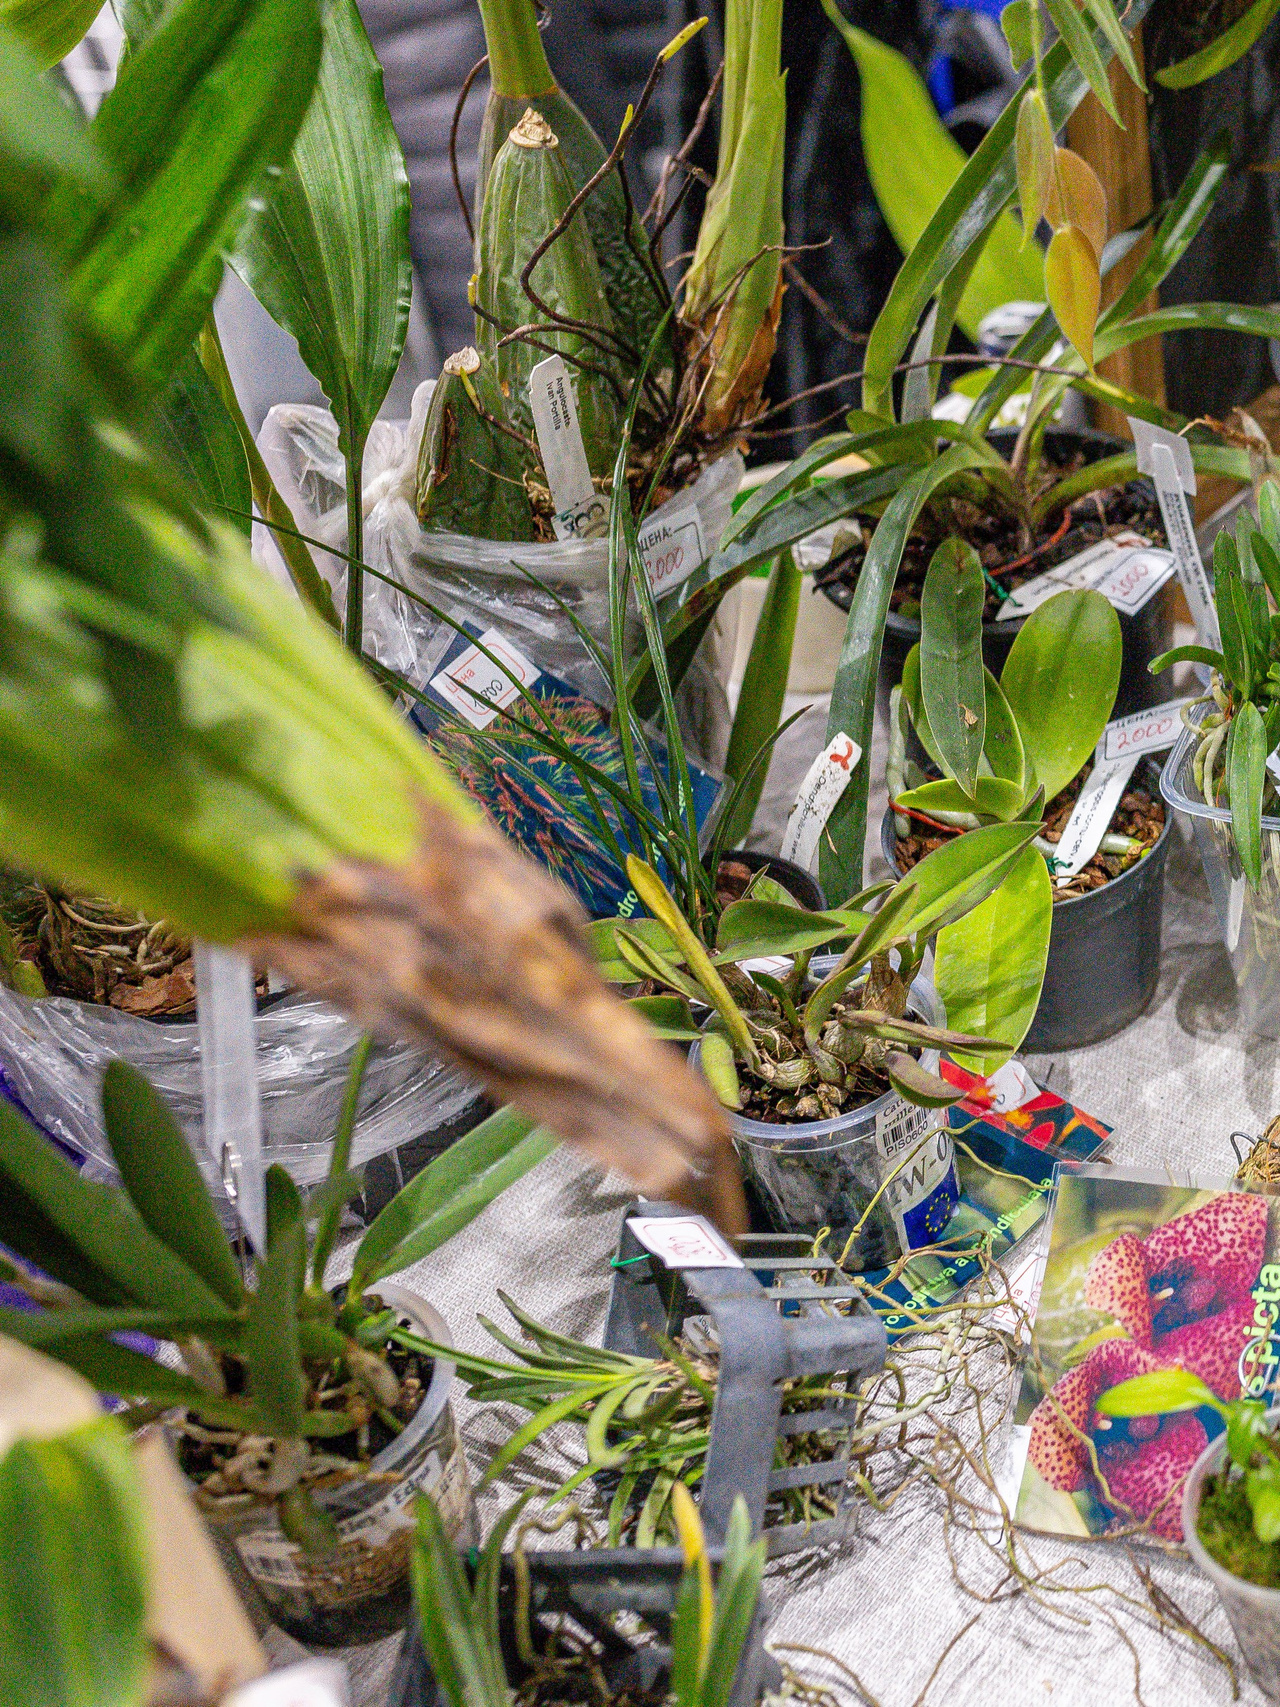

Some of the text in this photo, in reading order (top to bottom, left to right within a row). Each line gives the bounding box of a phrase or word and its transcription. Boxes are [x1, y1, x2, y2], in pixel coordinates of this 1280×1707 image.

[546, 381, 562, 431] Ivan Portilla
[556, 376, 571, 428] Angulocaste
[446, 668, 476, 694] Цна
[1116, 717, 1173, 748] 2000
[886, 1121, 928, 1156] PIS0600
